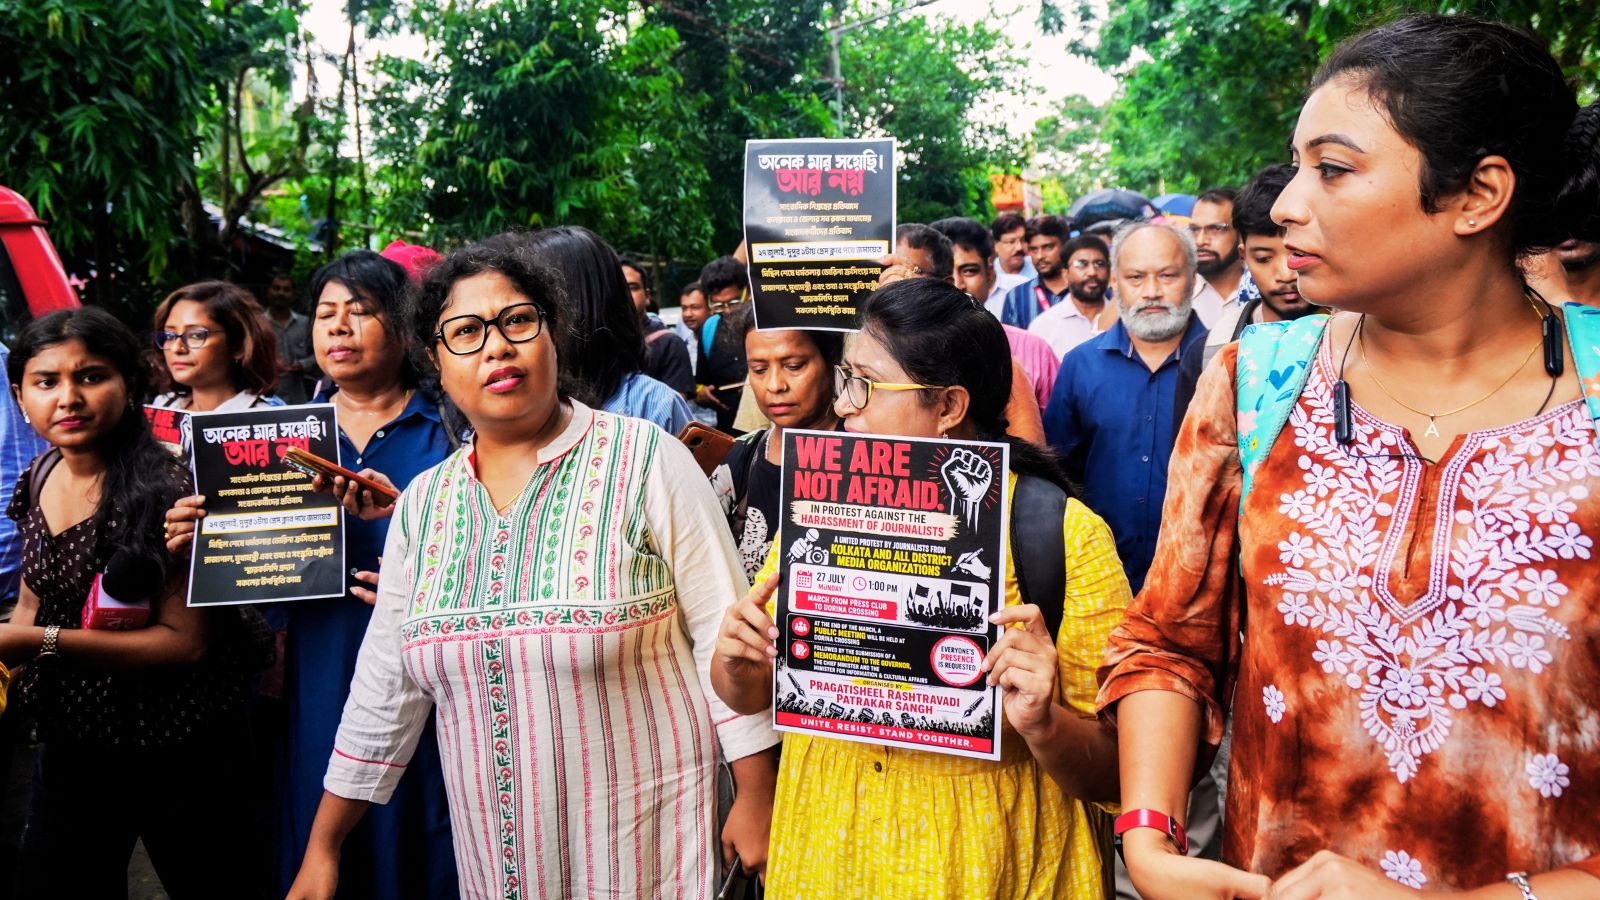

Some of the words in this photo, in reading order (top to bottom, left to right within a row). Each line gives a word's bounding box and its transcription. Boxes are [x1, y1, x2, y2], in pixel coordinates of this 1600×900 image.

[758, 155, 804, 170] অনেক
[808, 155, 832, 171] মার
[835, 149, 883, 173] সয়েছি।
[776, 169, 822, 196] আর
[828, 169, 864, 196] নয়
[768, 249, 786, 258] জুলাই,
[787, 248, 800, 258] দুপুর
[829, 248, 842, 256] ক্লাব
[203, 426, 250, 444] অনেক
[253, 423, 277, 441] মার
[280, 415, 326, 440] সয়েছি।
[1424, 422, 1439, 437] A
[222, 440, 270, 468] আর
[796, 436, 842, 470] WE
[849, 440, 910, 476] ARE
[794, 470, 842, 501] NOT
[846, 475, 944, 510] AFRAID.
[811, 504, 820, 513] IN
[822, 505, 862, 517] PROTEST
[864, 509, 905, 521] AGAINST
[909, 513, 926, 523] THE
[801, 514, 864, 530] HARASSMENT
[867, 520, 878, 530] OF
[881, 522, 944, 536] JOURNALISTS
[839, 536, 859, 545] UNITED
[859, 538, 884, 548] PROTEST
[892, 542, 930, 553] JOURNALISTS
[930, 546, 946, 554] FROM
[831, 543, 872, 558] KOLKATA
[873, 548, 892, 560] AND
[894, 550, 910, 562] ALL
[912, 552, 953, 566] DISTRICT
[837, 555, 865, 569] MEDIA
[867, 559, 941, 577] ORGANIZATIONS
[816, 572, 826, 581] 27
[828, 574, 846, 584] JULY
[868, 580, 885, 591] 1:00
[887, 584, 898, 592] PM
[808, 594, 830, 602] MARCH
[831, 597, 849, 605] FROM
[850, 600, 870, 608] PRESS
[871, 602, 888, 610] CLUB
[823, 604, 847, 613] DORINA
[848, 607, 879, 616] CROSSING
[814, 627, 837, 637] PUBLIC
[838, 630, 866, 639] MEETING
[834, 637, 860, 645] CROSSING
[814, 644, 838, 652] FOLLOWED
[855, 649, 884, 658] SUBMISSION
[941, 646, 975, 655] EVERYONE'S
[941, 654, 974, 663] PRESENCE
[814, 652, 860, 663] MEMORANDUM
[870, 658, 880, 666] THE
[881, 659, 912, 670] GOVERNOR,
[837, 662, 859, 670] MINISTER
[945, 662, 978, 671] REQUESTED.
[814, 665, 835, 673] MINISTER
[846, 669, 878, 678] INFORMATION
[883, 673, 907, 682] CULTURAL
[908, 676, 928, 684] AFFAIRS
[810, 679, 884, 698] PRAGATISHEEL
[888, 689, 960, 707] RASHTRAVADI
[863, 680, 895, 688] ORGANISED
[836, 694, 892, 710] PATRAKAR
[895, 701, 933, 715] SANGH
[800, 717, 834, 728] UNITE.
[837, 723, 875, 734] RESIST.
[879, 728, 913, 739] STAND
[916, 733, 974, 748] TOGETHER.
